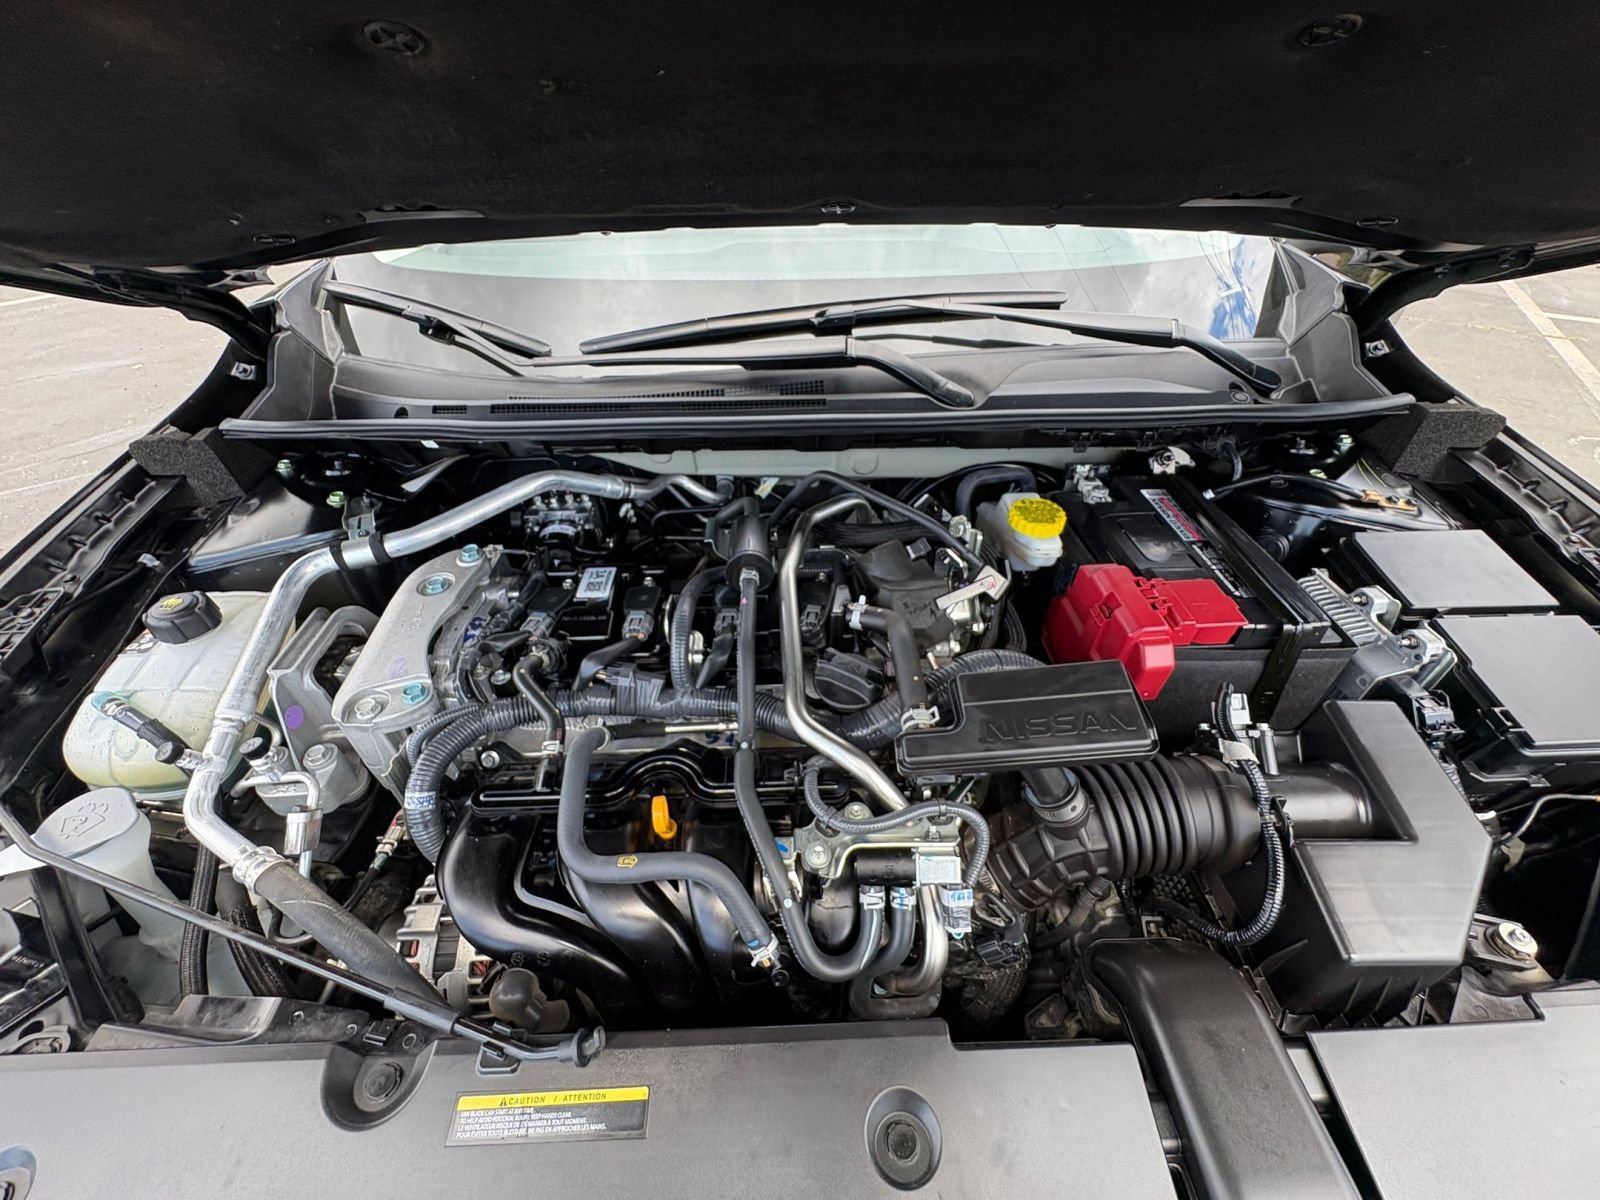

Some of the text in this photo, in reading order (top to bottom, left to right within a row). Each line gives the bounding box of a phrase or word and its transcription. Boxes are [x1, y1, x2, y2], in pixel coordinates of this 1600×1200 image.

[981, 711, 1138, 742] NISSAN
[508, 1097, 545, 1105] CAUTION
[562, 1093, 607, 1102] ATTENTION
